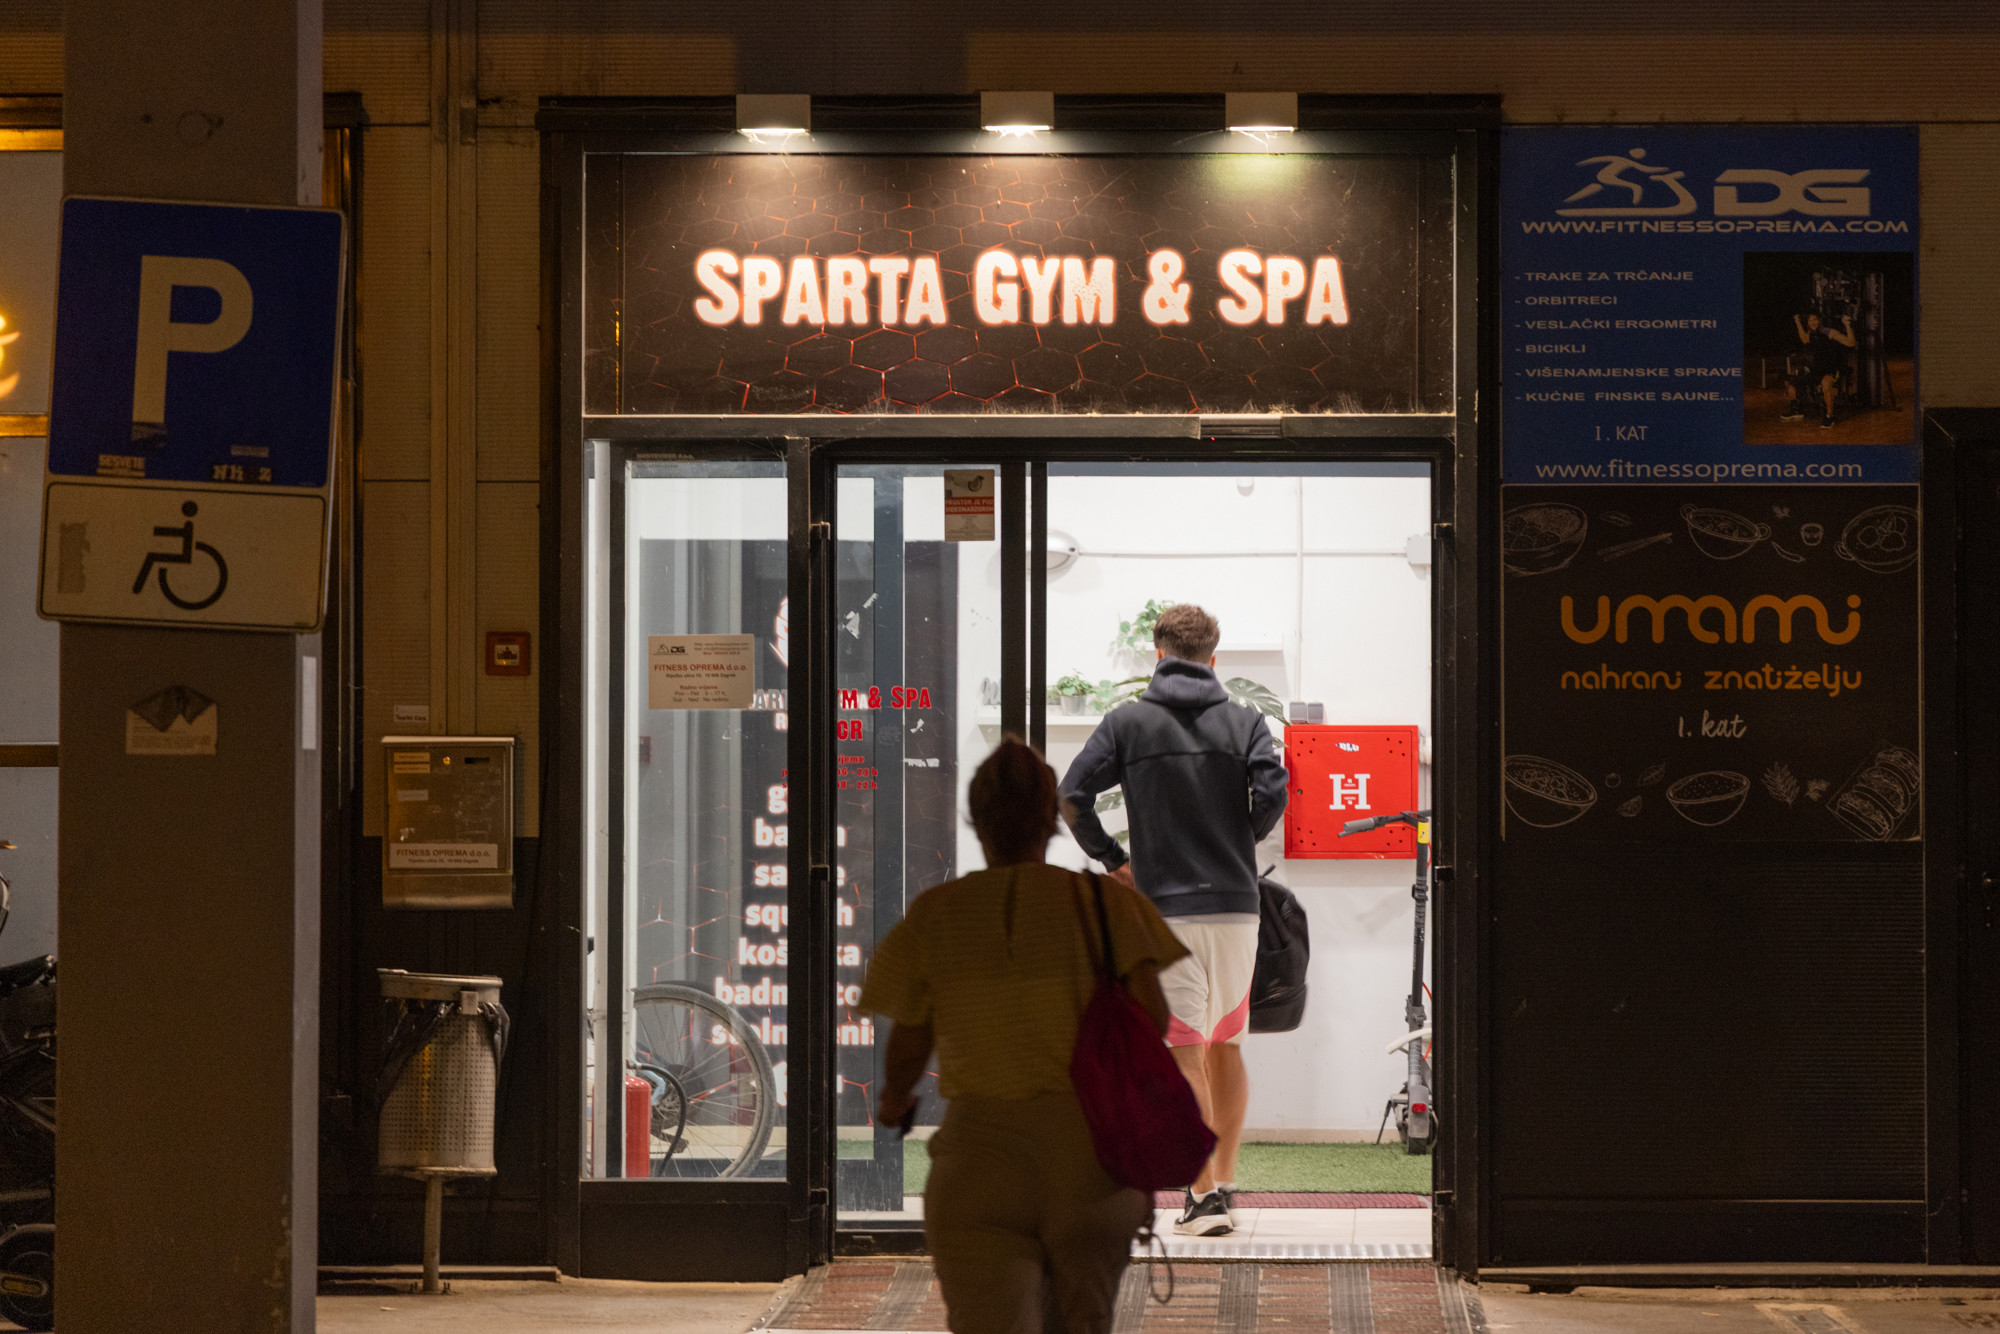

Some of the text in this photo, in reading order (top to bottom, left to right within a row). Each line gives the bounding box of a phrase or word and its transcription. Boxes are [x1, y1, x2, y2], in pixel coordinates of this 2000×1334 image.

[1713, 168, 1871, 216] DG
[1520, 219, 1909, 234] WWW.FITNESSOPREMA.COM
[1525, 271, 1583, 281] TRAKE
[1587, 271, 1610, 281] ZA
[1613, 268, 1694, 281] TRČANJE
[694, 250, 1350, 326] SPARTA GYM & SPA
[1525, 295, 1618, 305] ORBITRECI
[1525, 317, 1610, 329] VESLAČKI
[1614, 319, 1718, 329] ERGOMETRI
[132, 255, 254, 441] P
[1525, 343, 1586, 354] BICIKLI
[1525, 365, 1669, 377] VIŠENAMJENSKE
[1674, 367, 1742, 377] SPRAVE
[1595, 391, 1656, 401] FINSKE
[1616, 425, 1649, 441] KAT
[1535, 458, 1863, 483] www.fitnessoprema.com
[1560, 594, 1862, 645] umami
[689, 663, 725, 671] OPREMA
[1560, 662, 1682, 690] nahrani
[890, 685, 932, 709] SPA
[1701, 709, 1748, 738] kat
[837, 754, 865, 765] ijeme
[857, 767, 870, 777] 23
[856, 780, 869, 790] 22
[396, 849, 431, 857] FITNESS
